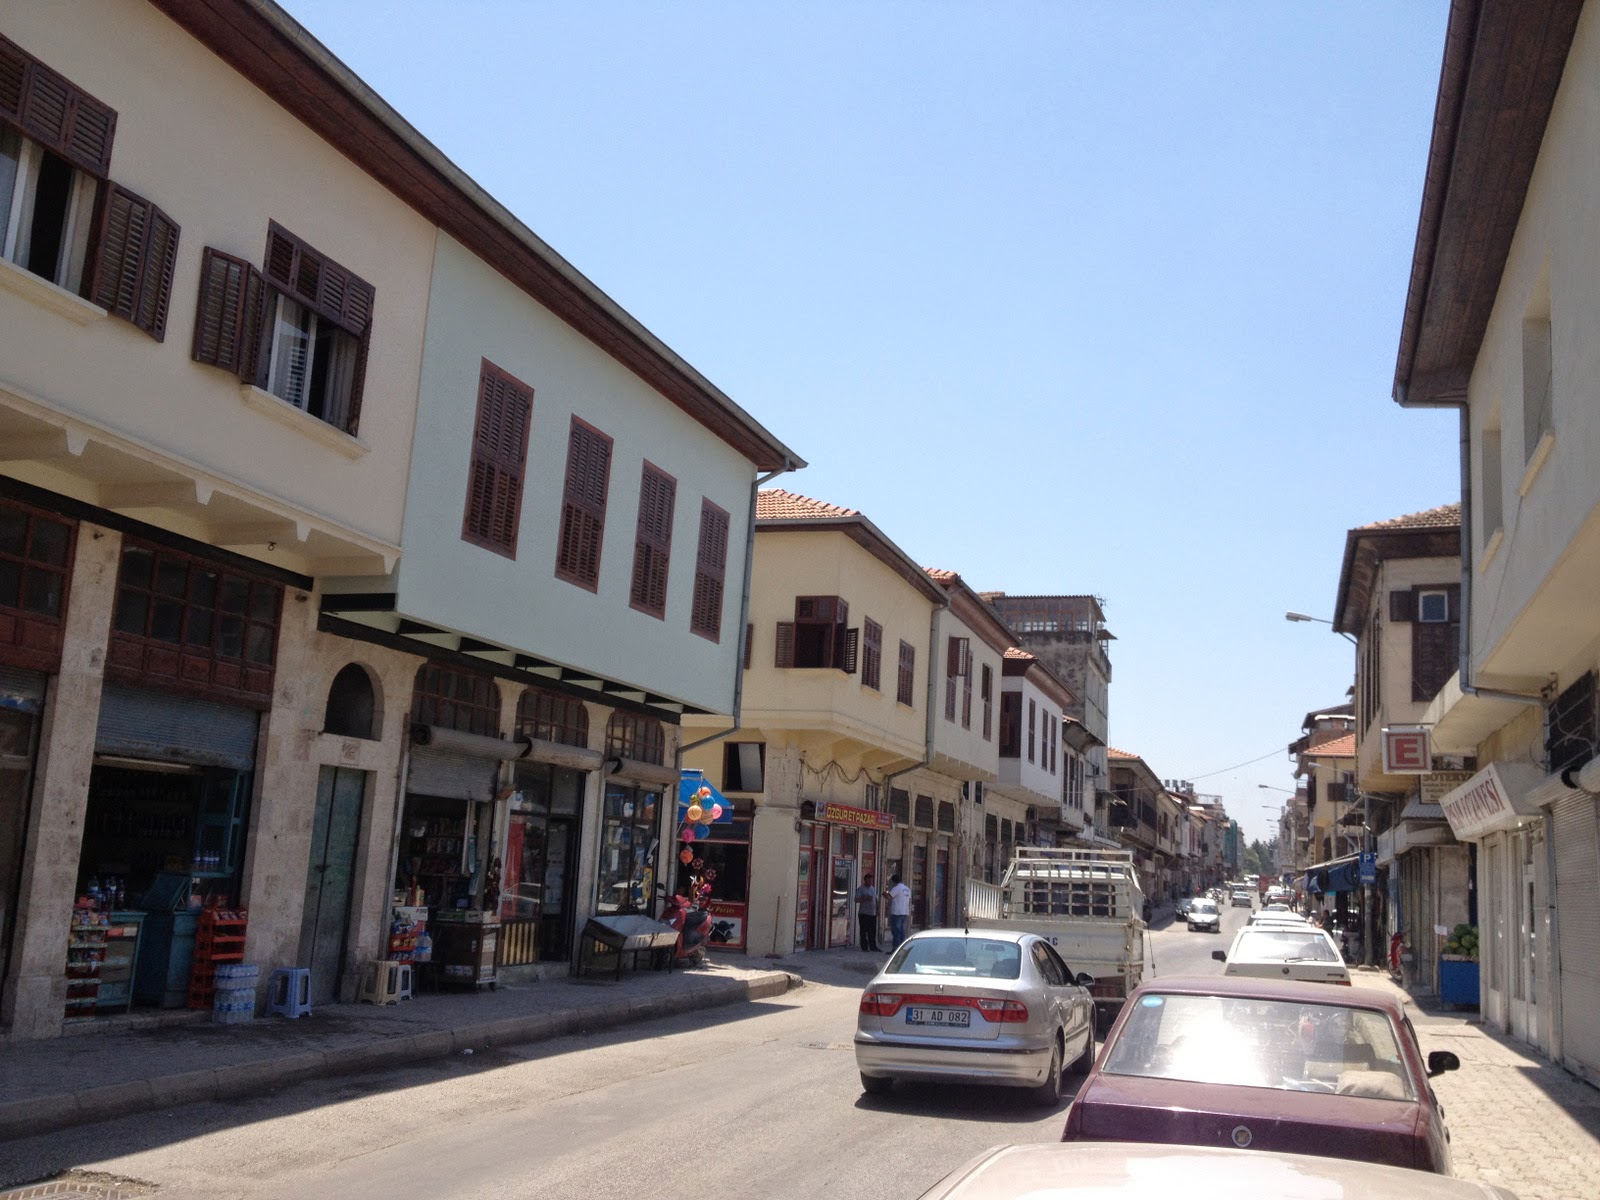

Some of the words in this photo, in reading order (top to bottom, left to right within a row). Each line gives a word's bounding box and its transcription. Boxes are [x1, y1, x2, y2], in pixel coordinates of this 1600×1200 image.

[1396, 739, 1419, 764] E
[848, 810, 856, 822] ET
[1364, 854, 1371, 863] P
[913, 1009, 923, 1020] 31
[931, 1011, 943, 1021] AD
[948, 1012, 967, 1023] 082
